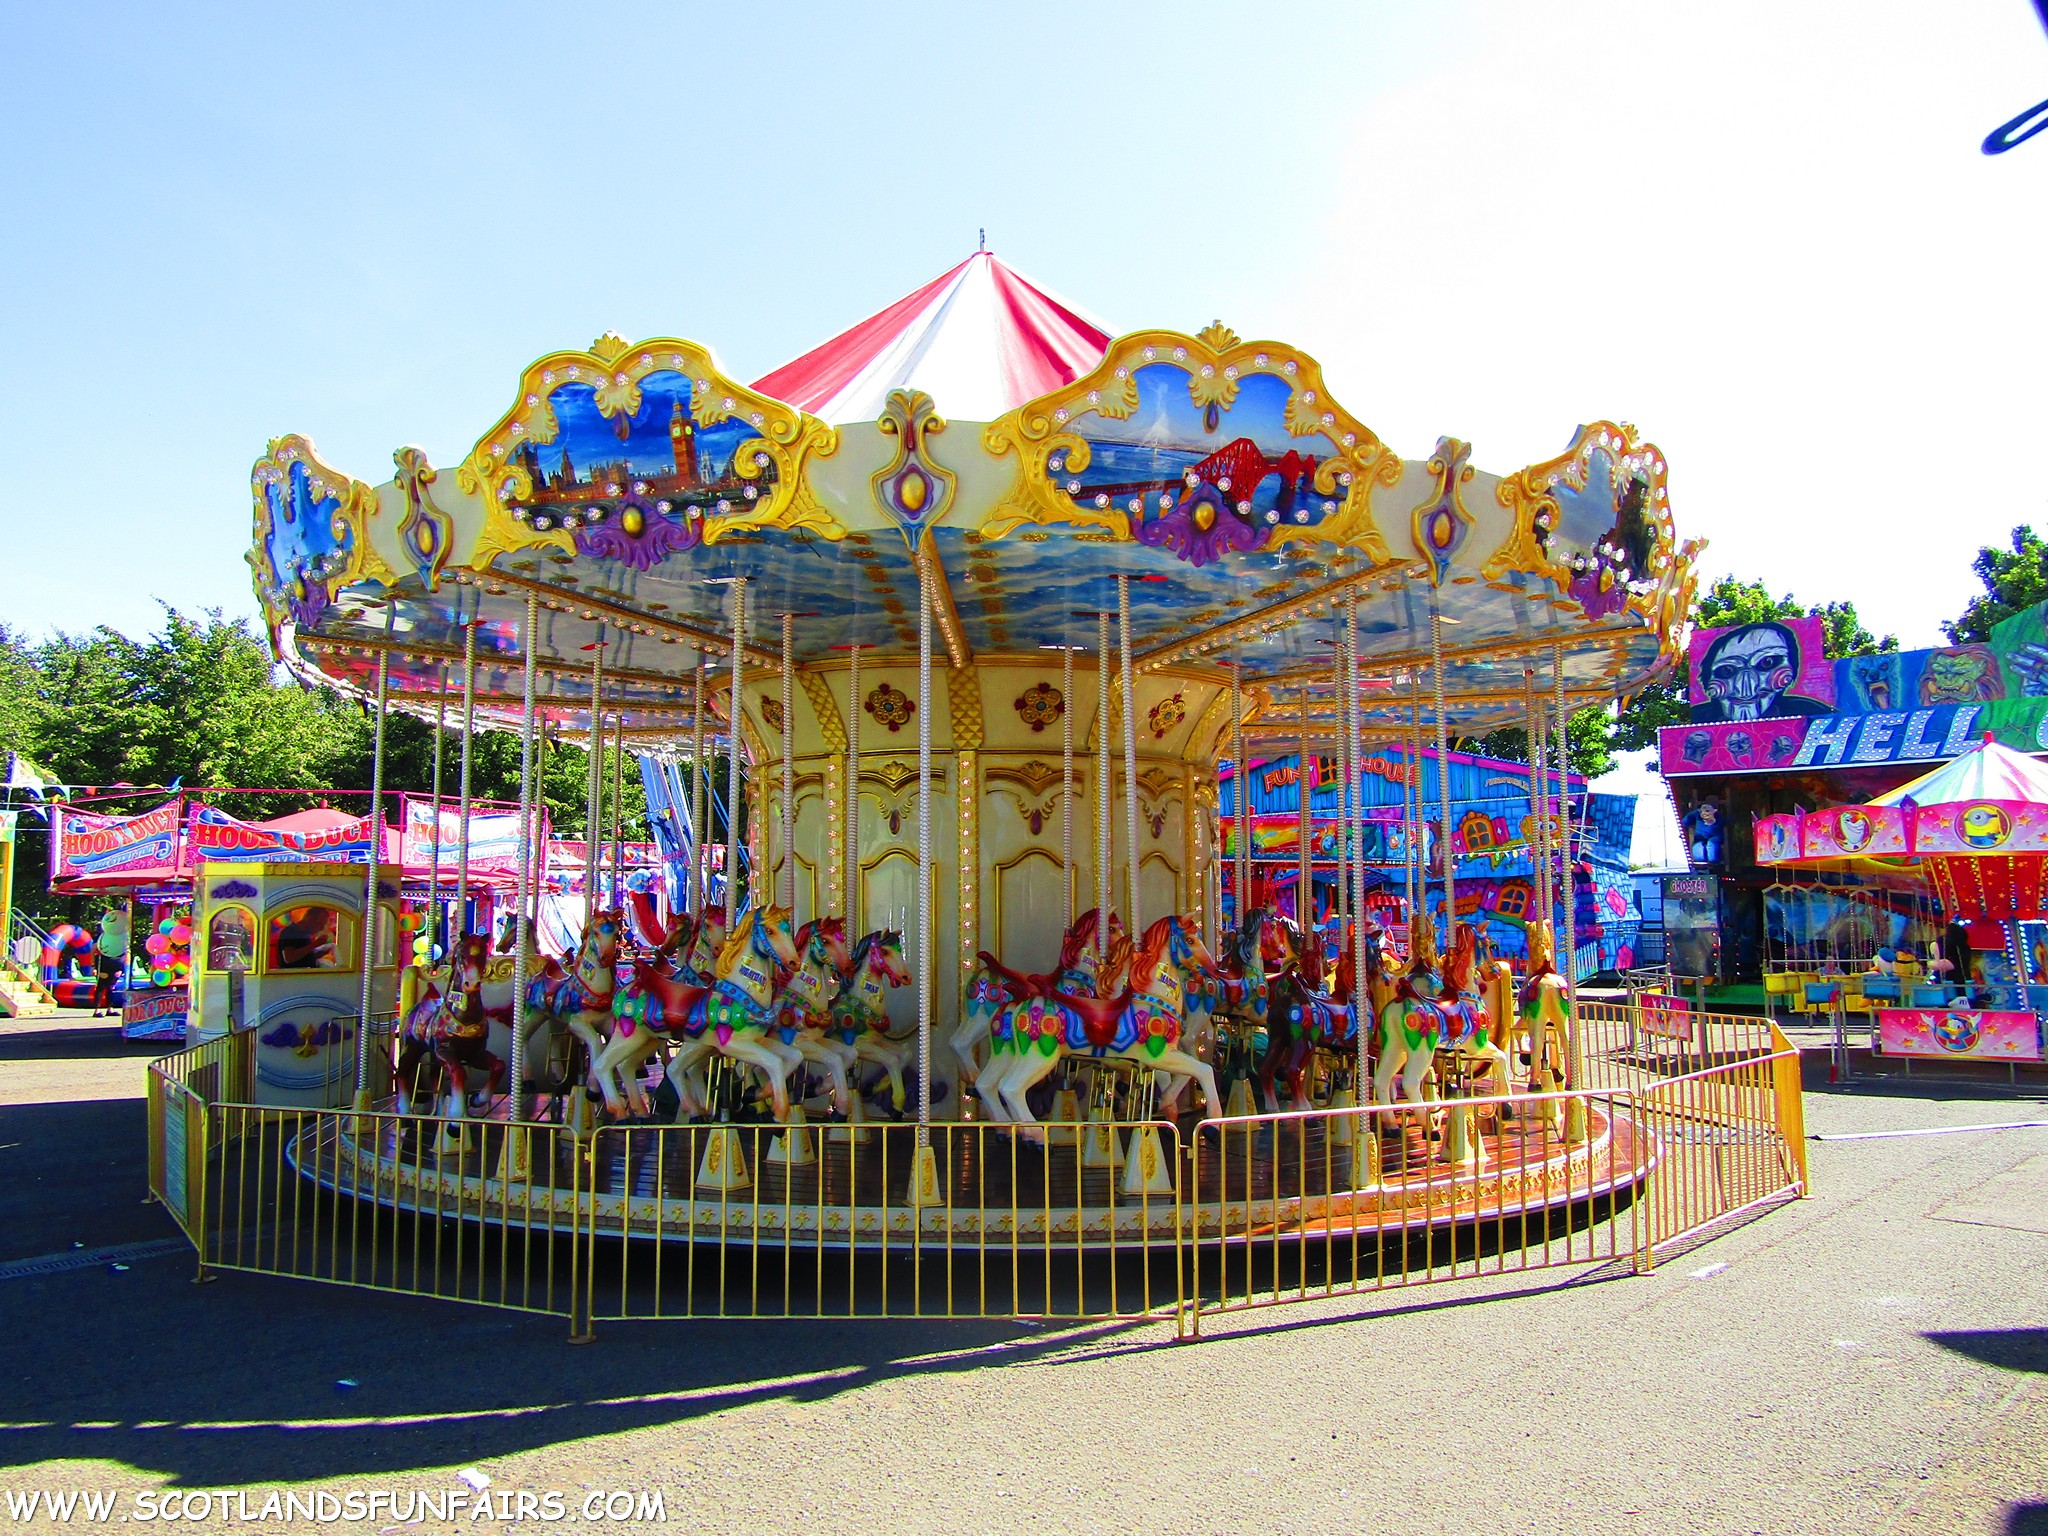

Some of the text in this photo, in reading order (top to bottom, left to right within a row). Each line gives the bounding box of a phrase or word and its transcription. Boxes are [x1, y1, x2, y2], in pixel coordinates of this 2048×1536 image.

[1792, 705, 1984, 765] HELL
[1264, 756, 1415, 793] FUN HOUSE
[64, 829, 121, 857] HOOK
[125, 808, 176, 841] DUCK
[195, 823, 281, 850] HOOK
[303, 820, 374, 851] DUCK
[412, 822, 470, 844] HOO
[266, 864, 361, 876] TICKETS
